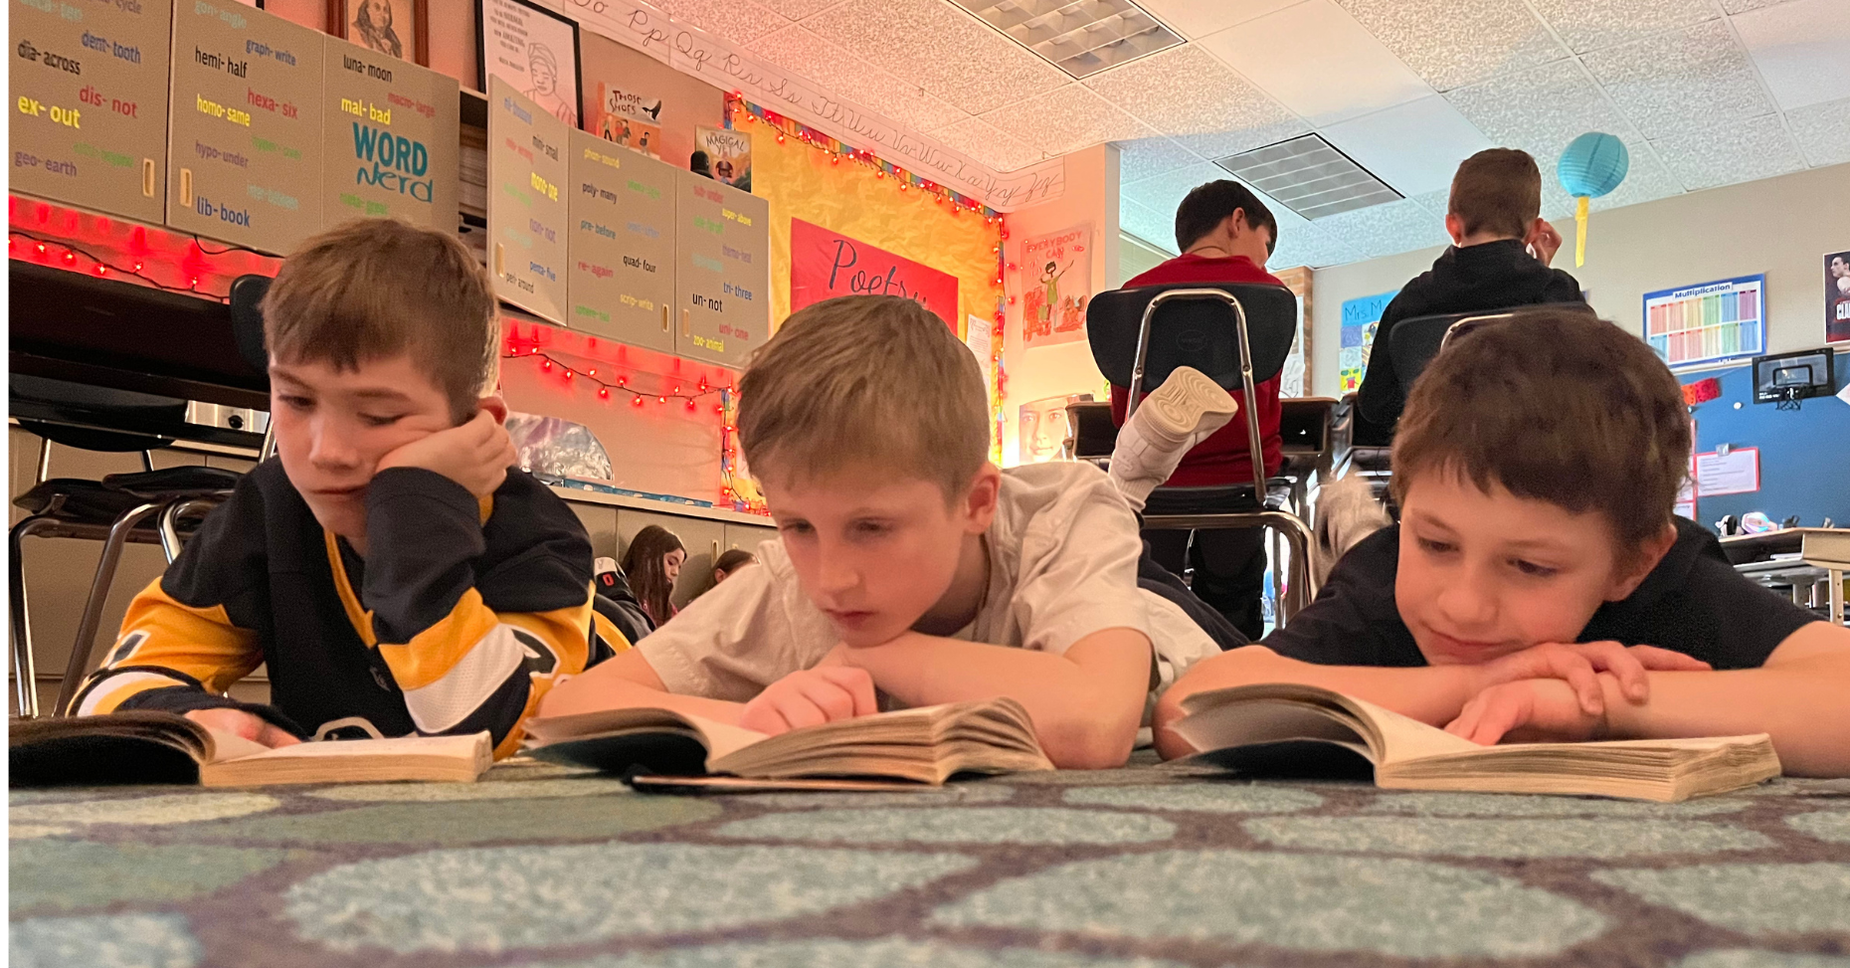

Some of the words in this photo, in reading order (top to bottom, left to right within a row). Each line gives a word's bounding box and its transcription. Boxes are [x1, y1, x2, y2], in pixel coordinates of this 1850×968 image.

[43, 51, 81, 75] across
[113, 41, 141, 64] tooth
[195, 45, 225, 70] hemi-
[227, 56, 247, 78] half
[246, 39, 273, 57] graph-
[275, 50, 296, 66] write
[343, 54, 365, 74] luna-
[367, 63, 392, 83] moon
[17, 95, 46, 117] ex-
[50, 105, 81, 129] out
[79, 84, 107, 107] dis-
[112, 98, 138, 119] not
[196, 92, 225, 118] homo-
[227, 107, 250, 127] same
[247, 86, 279, 112] hexa-
[282, 102, 298, 119] six
[341, 98, 367, 117] mal-
[369, 102, 391, 125] bad
[195, 139, 221, 161] hypo-
[222, 150, 249, 168] under
[352, 121, 428, 178] WORD
[705, 135, 745, 152] MAGICAL
[15, 151, 42, 167] geo-
[46, 158, 77, 177] earth
[357, 161, 434, 203] Nerd
[582, 183, 599, 198] poly-
[600, 189, 618, 205] many
[197, 195, 218, 217] lib-
[220, 203, 251, 228] book
[595, 222, 617, 240] before
[1026, 231, 1083, 253] EVERYBODY
[623, 255, 642, 270] quad-
[643, 259, 656, 274] four
[692, 292, 707, 307] un-
[708, 298, 723, 313] not
[723, 282, 734, 295] tri-
[735, 285, 753, 301] three
[1674, 284, 1731, 299] Multiplication
[706, 337, 724, 353] animal
[735, 328, 749, 341] one
